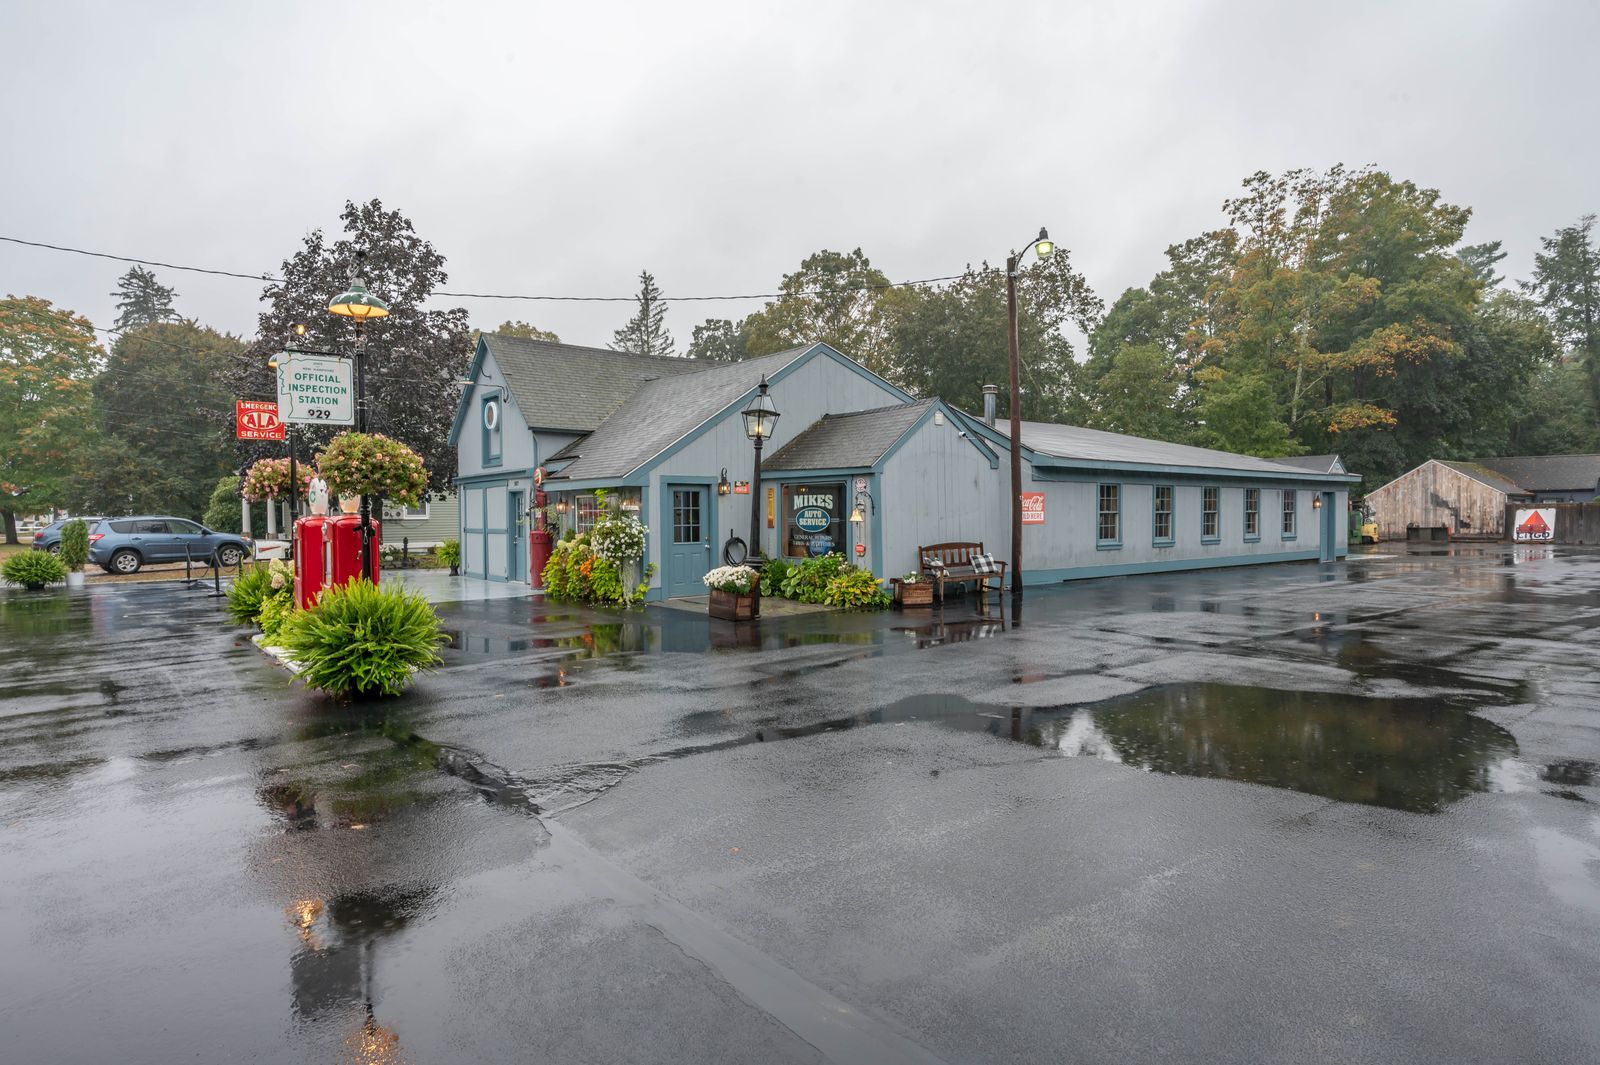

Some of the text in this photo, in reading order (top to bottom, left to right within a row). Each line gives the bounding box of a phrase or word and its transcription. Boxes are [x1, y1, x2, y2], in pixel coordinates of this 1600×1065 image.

[294, 372, 341, 383] OFFICIAL
[288, 383, 347, 395] INSPECTION
[298, 395, 339, 406] STATION
[240, 402, 278, 411] EMERGENC
[308, 408, 331, 419] 929
[246, 411, 276, 429] ALA
[240, 430, 282, 438] SERVICE
[793, 495, 833, 510] MIKES
[804, 510, 822, 518] AUTO
[799, 518, 827, 526] SERVICE
